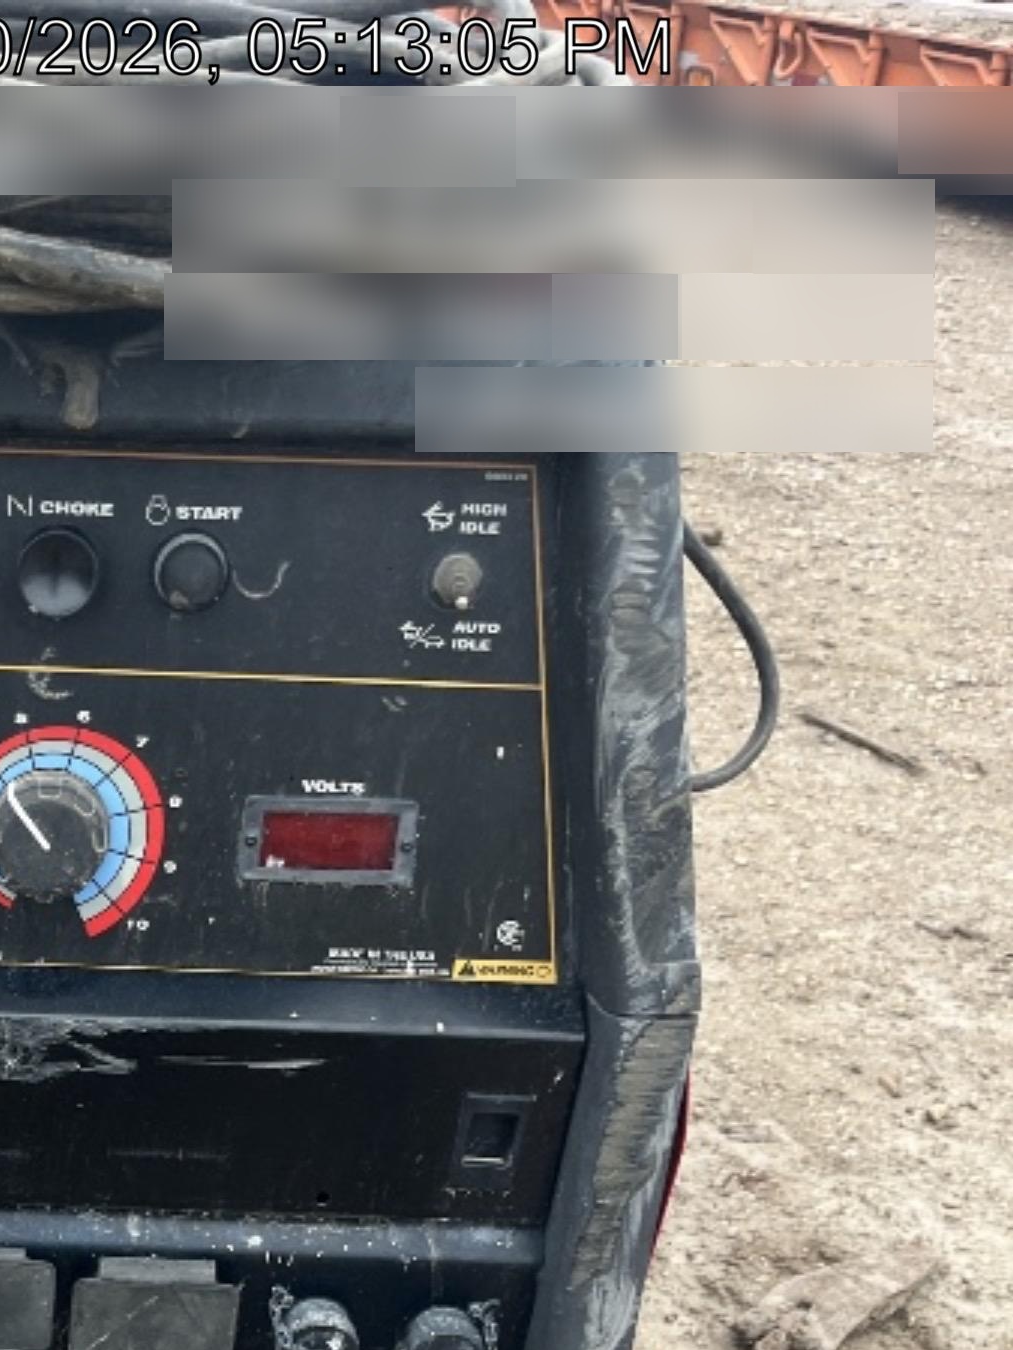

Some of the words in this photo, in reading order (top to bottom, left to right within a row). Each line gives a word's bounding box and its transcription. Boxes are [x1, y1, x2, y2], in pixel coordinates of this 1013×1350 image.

[40, 501, 115, 518] CHOKE
[175, 505, 243, 521] START
[460, 503, 508, 517] HIGH
[458, 520, 502, 536] IDLE
[452, 621, 502, 636] AUTO
[451, 637, 494, 652] IDLE
[301, 778, 366, 795] VOLTS
